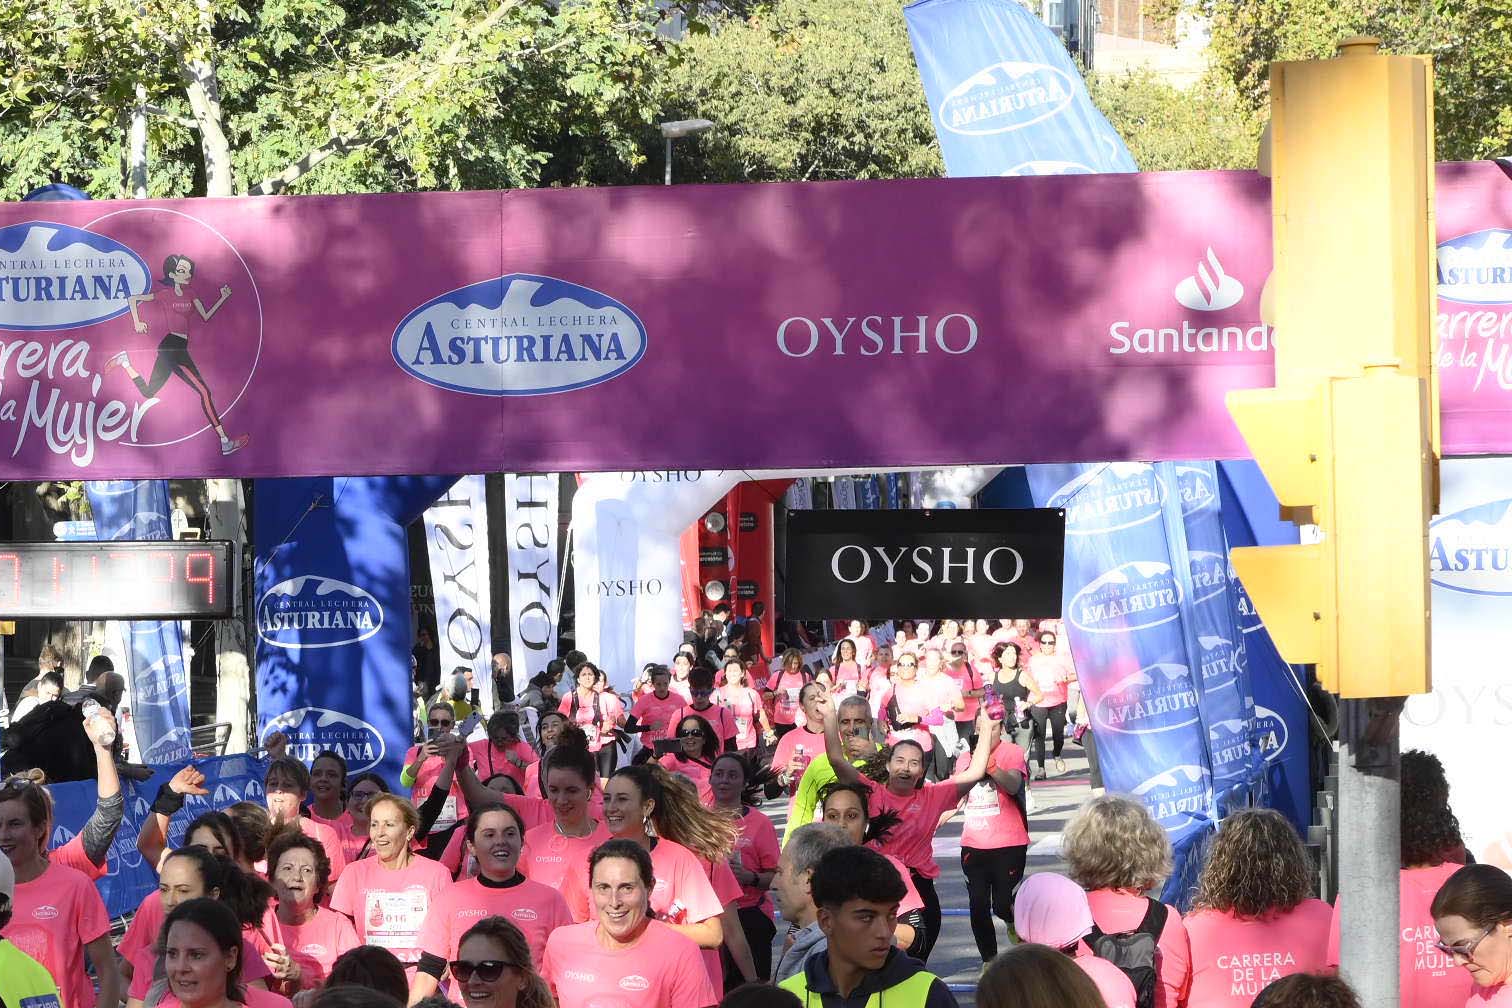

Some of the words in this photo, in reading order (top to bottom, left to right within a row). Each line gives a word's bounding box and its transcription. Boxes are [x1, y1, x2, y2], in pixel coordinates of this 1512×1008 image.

[53, 258, 126, 270] LECHERA
[451, 315, 530, 331] CENTRAL
[538, 313, 620, 328] LECHERA
[412, 321, 627, 365] ASTURIANA
[777, 313, 979, 358] OYSHO
[12, 373, 160, 467] Mujer
[1430, 536, 1512, 572] ASTU
[831, 544, 1024, 586] OYSHO
[588, 579, 662, 597] OYSHO
[273, 601, 316, 609] CENTRAL
[321, 600, 370, 608] LECHERA
[262, 606, 375, 632] ASTURIANA
[321, 731, 370, 740] LECHERA
[285, 743, 376, 762] TURANA
[1217, 951, 1296, 969] CARRERA
[1415, 954, 1454, 970] MUJE
[1233, 968, 1258, 982] DE
[1262, 967, 1282, 981] LA
[1230, 980, 1269, 996] MUJ
